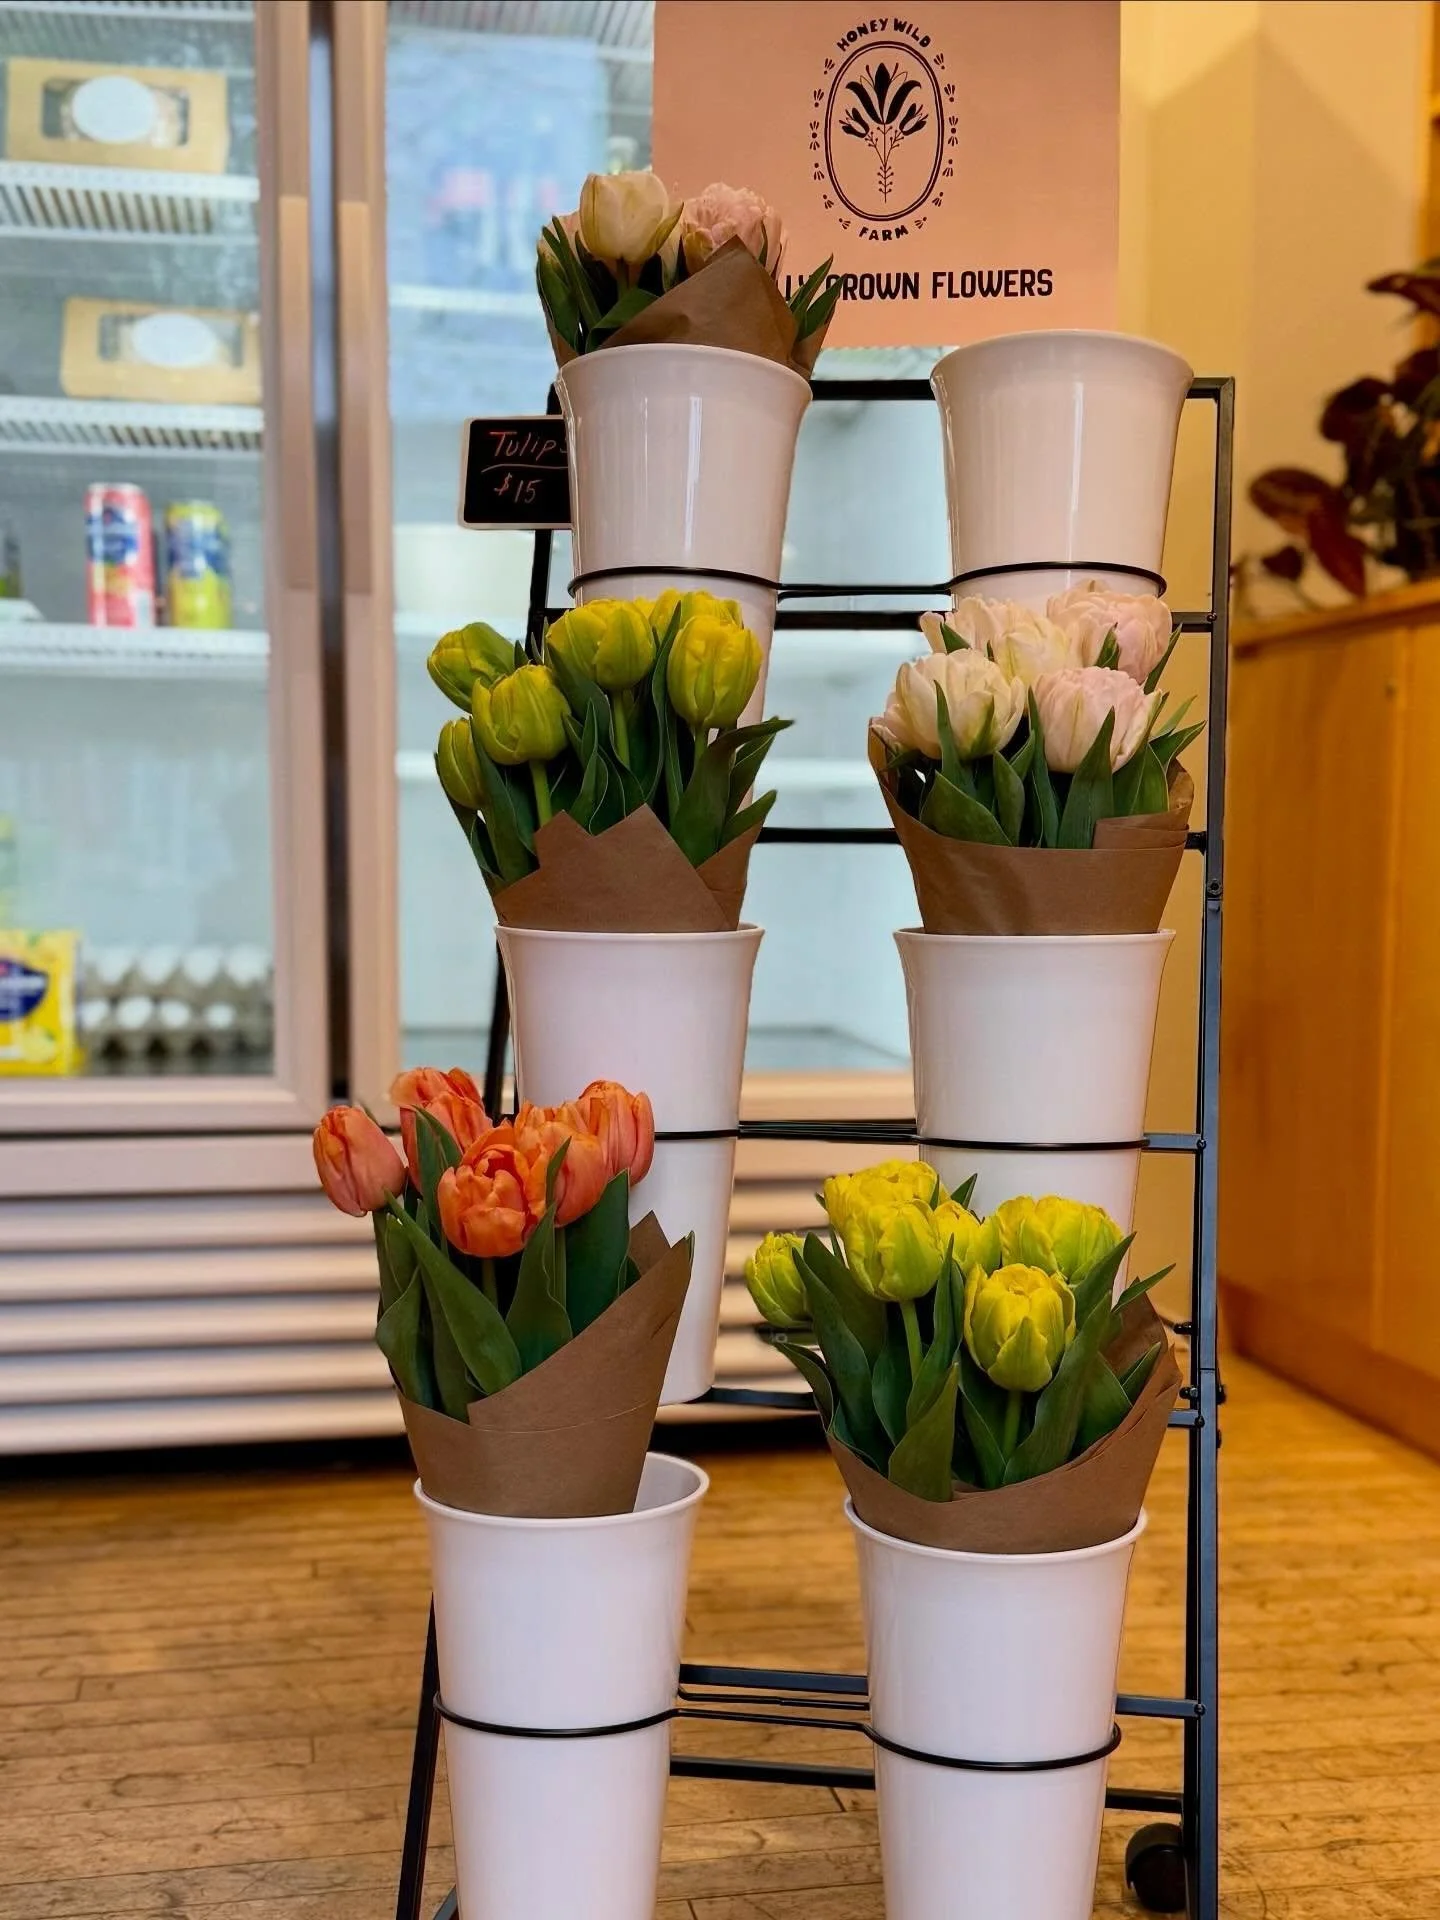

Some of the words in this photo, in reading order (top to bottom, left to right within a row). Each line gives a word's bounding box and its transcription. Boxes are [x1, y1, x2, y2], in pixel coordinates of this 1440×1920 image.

[836, 18, 888, 51] HONEY
[893, 18, 931, 47] WILD
[858, 225, 909, 241] FARM
[932, 269, 1053, 299] FLOWERS
[493, 472, 542, 503] $15
